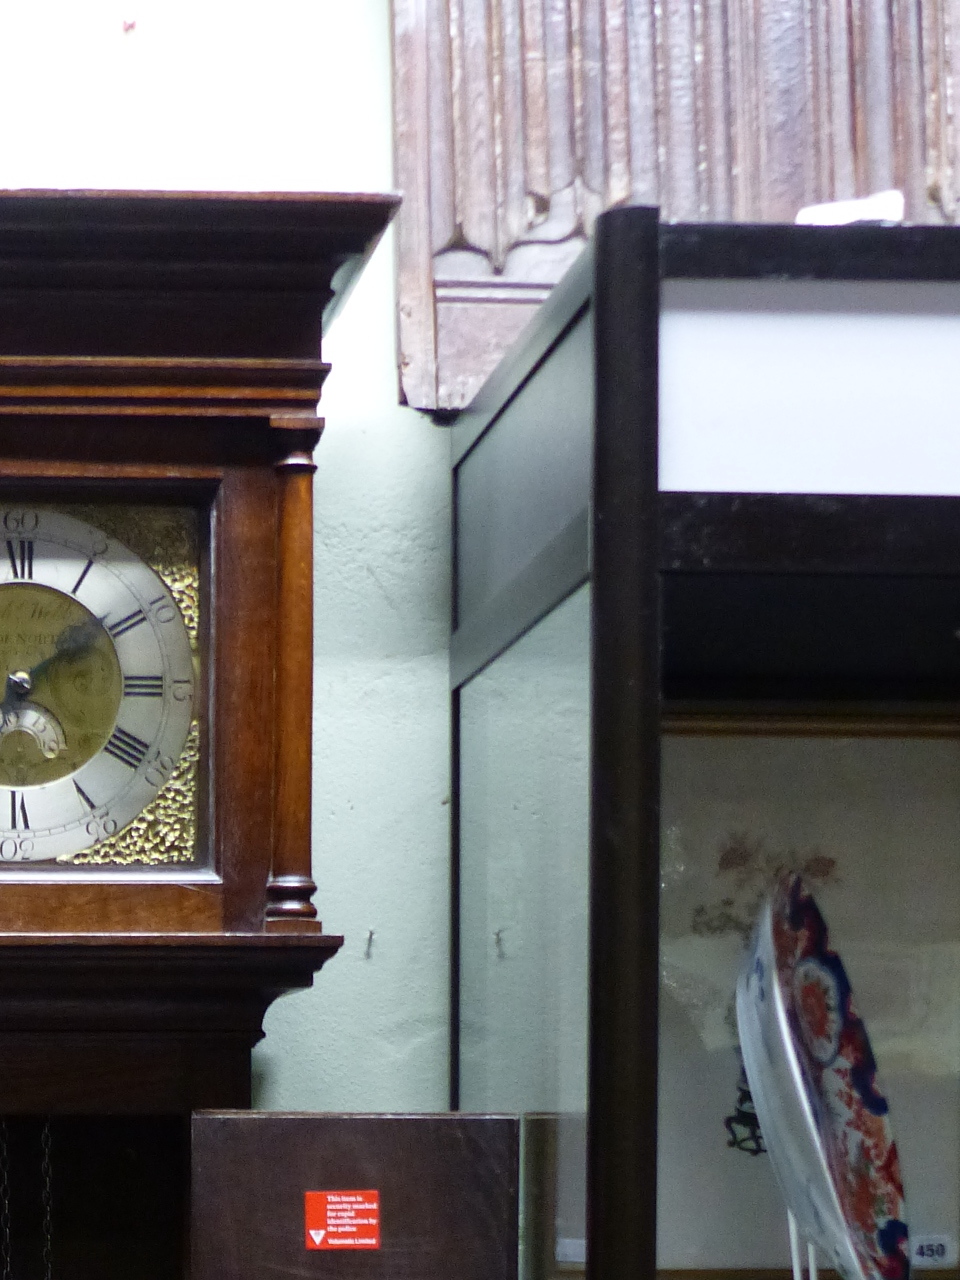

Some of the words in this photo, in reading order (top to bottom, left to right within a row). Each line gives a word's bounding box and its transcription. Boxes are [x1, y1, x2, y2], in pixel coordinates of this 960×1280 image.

[3, 510, 39, 531] 60
[149, 594, 176, 624] 10
[123, 675, 163, 697] III
[326, 1217, 368, 1225] identification
[368, 1217, 378, 1226] by
